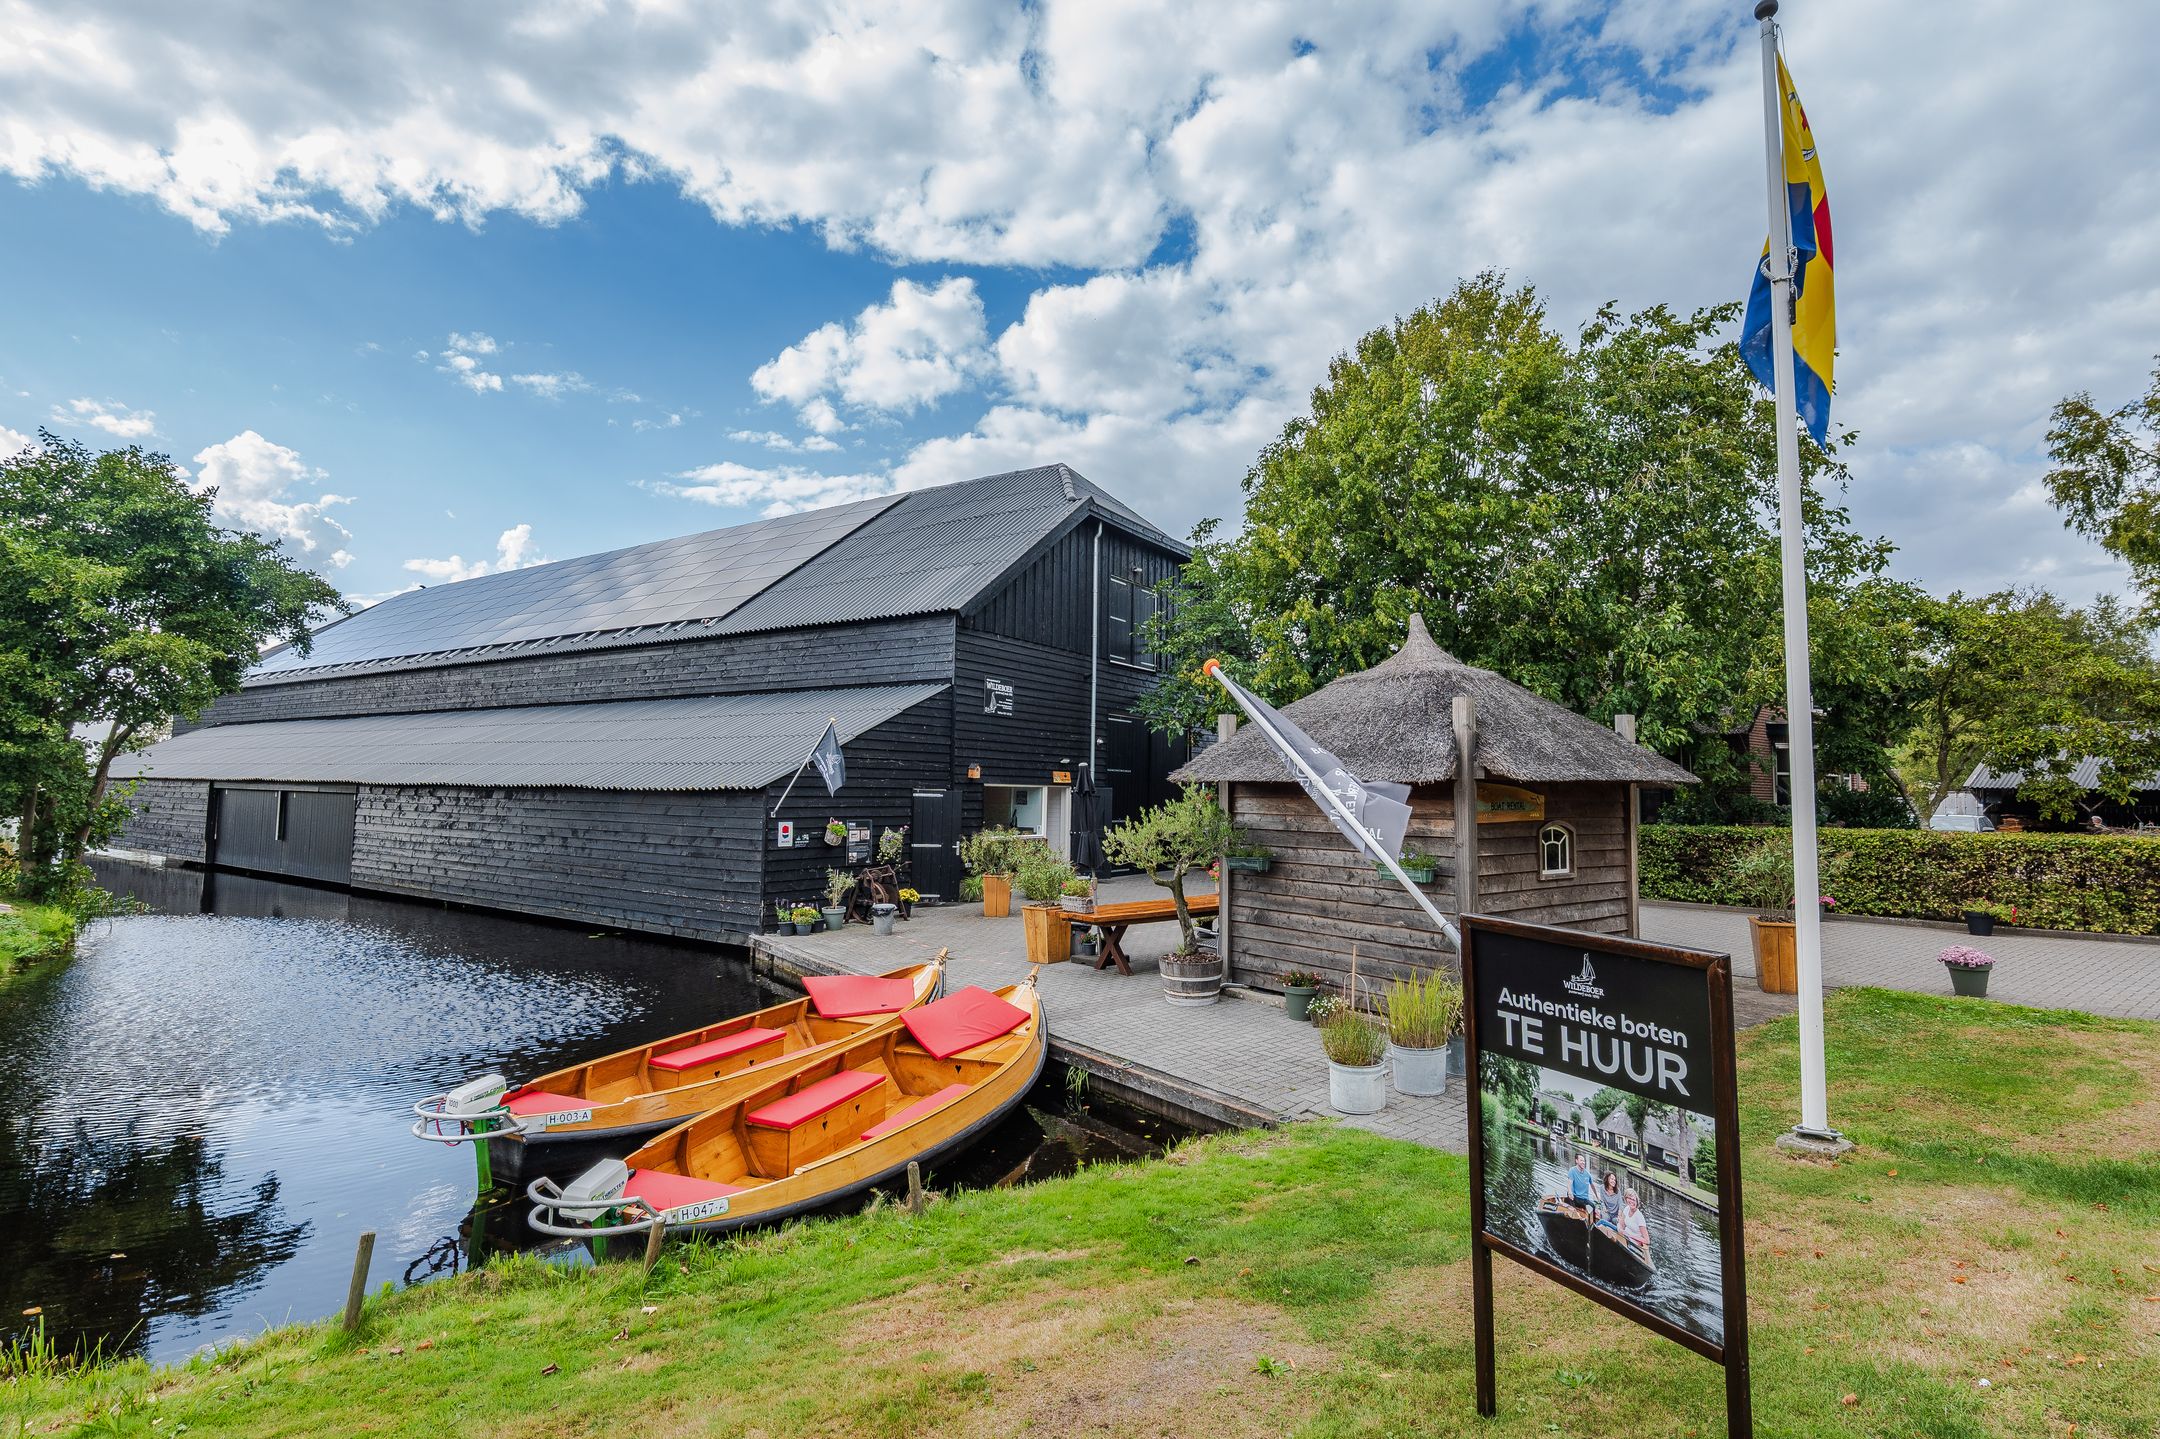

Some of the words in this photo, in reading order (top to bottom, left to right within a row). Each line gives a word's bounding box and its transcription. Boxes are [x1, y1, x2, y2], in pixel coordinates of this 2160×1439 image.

[1498, 987, 1616, 1031] Authentieke
[1620, 1013, 1688, 1049] boten
[1563, 980, 1605, 996] WILDEBOER
[1497, 1009, 1544, 1055] TE
[1560, 1025, 1691, 1097] HUUR
